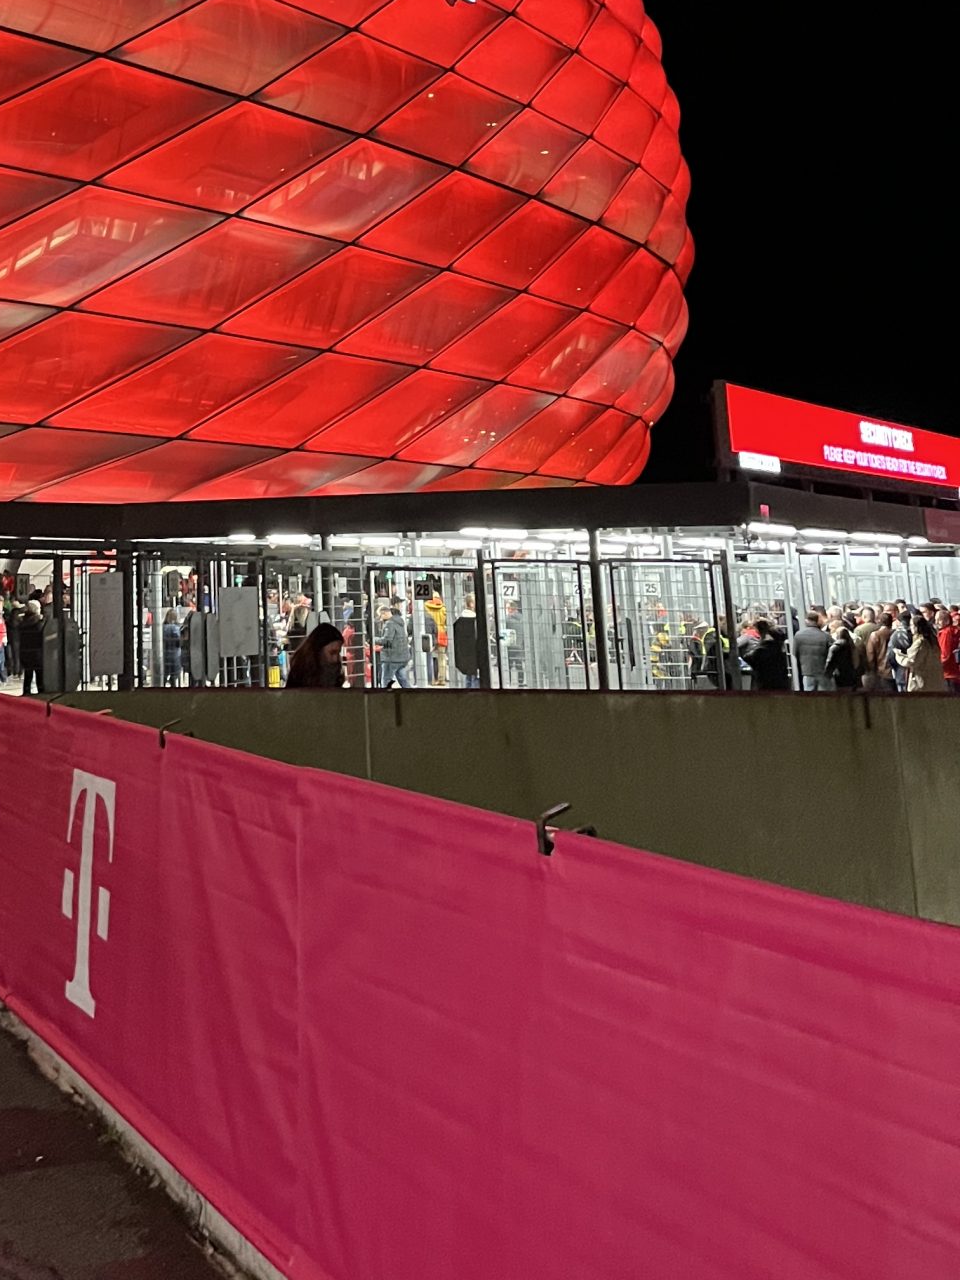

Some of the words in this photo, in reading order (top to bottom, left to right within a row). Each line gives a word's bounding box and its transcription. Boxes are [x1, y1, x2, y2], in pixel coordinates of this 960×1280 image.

[416, 584, 430, 596] 28
[503, 585, 515, 596] 27
[645, 583, 657, 593] 25
[63, 769, 116, 1018] T
